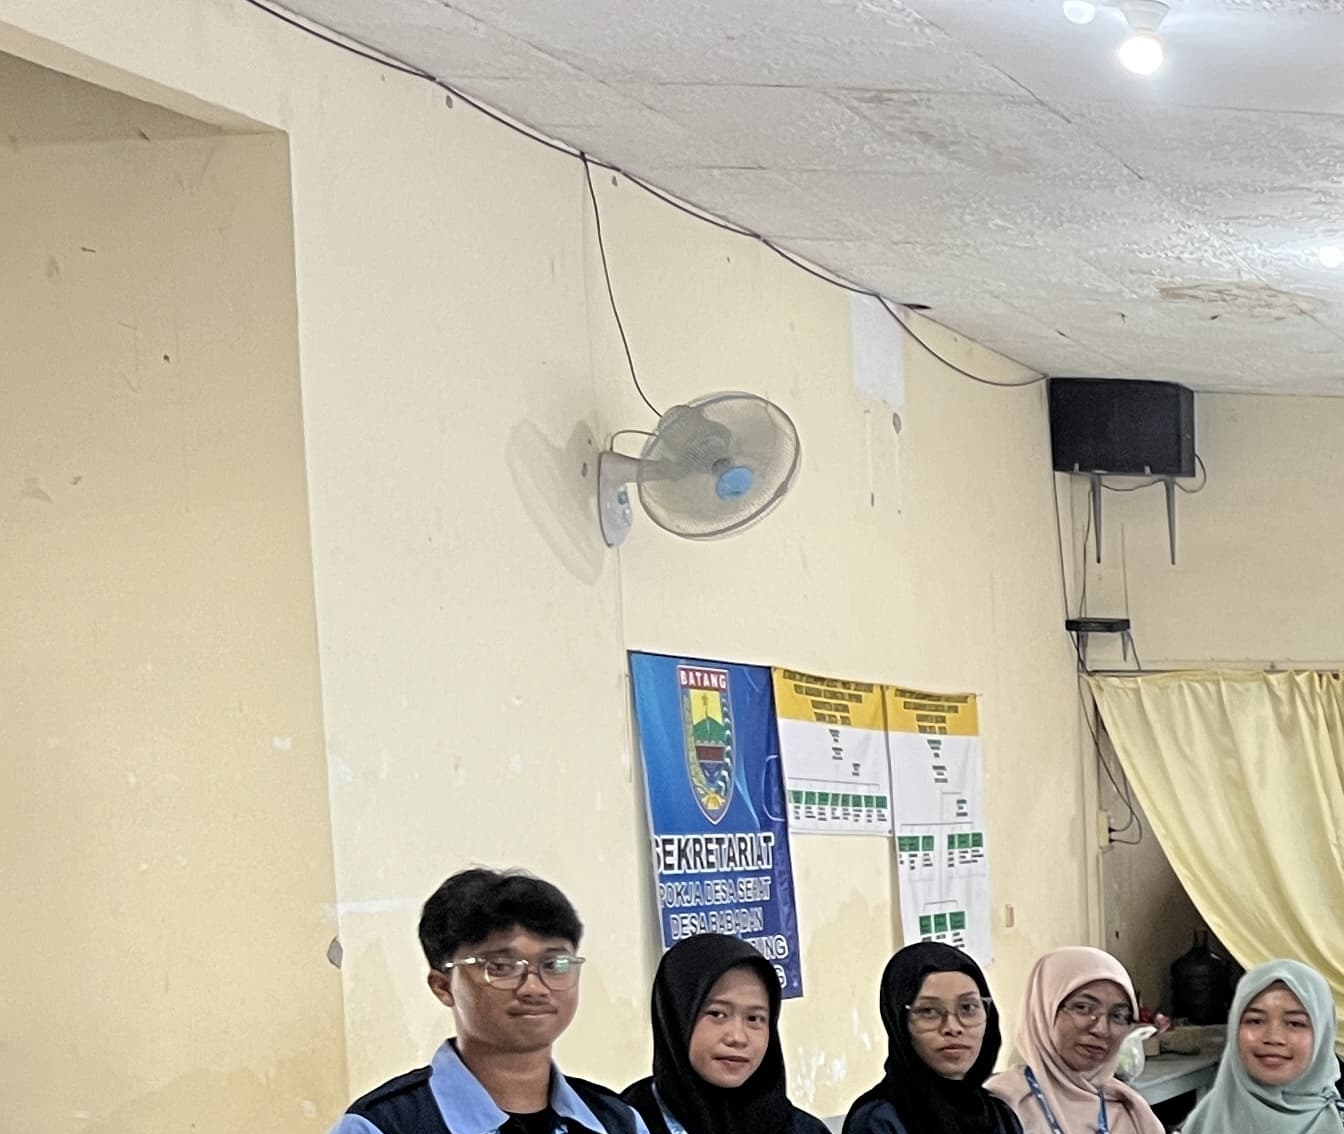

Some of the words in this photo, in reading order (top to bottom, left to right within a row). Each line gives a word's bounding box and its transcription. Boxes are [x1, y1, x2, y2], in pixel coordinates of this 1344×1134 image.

[680, 669, 727, 689] BATANG
[659, 881, 703, 908] POKJA
[705, 879, 736, 904] DESA
[737, 876, 771, 902] SEHAT
[670, 912, 708, 939] DESA
[709, 907, 763, 935] BABADAN
